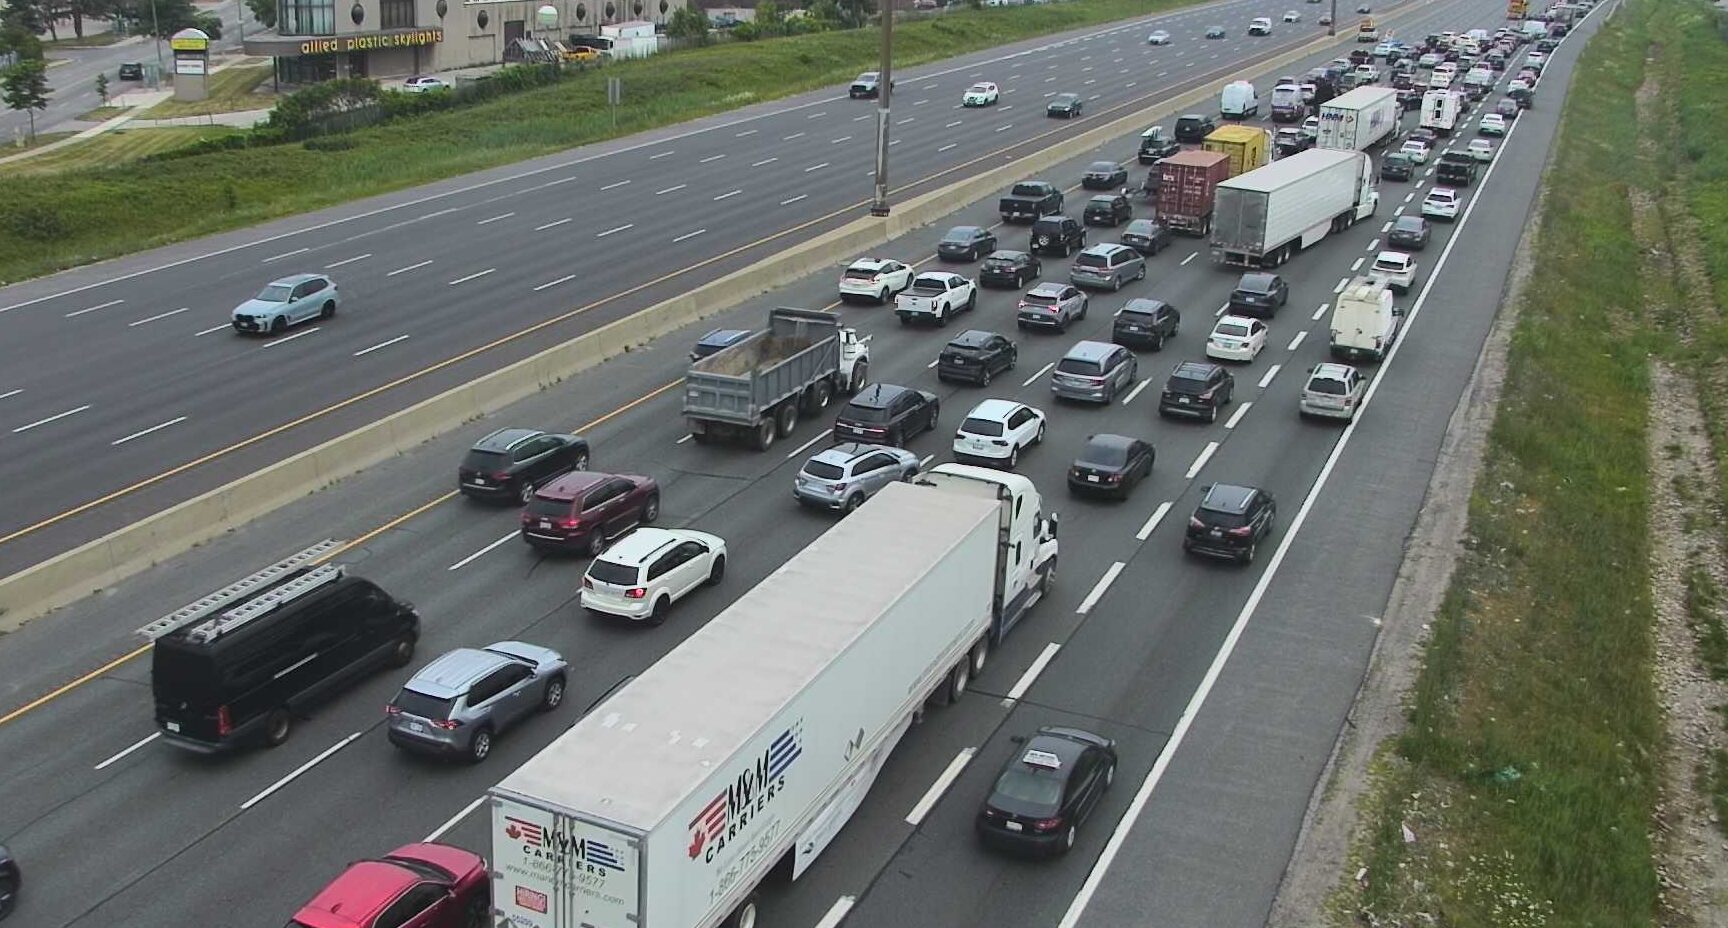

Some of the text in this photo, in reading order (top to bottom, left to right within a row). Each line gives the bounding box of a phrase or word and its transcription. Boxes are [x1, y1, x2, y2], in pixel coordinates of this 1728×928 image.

[301, 29, 442, 54] allied plastic skylights
[705, 776, 785, 863] CARRIERS
[523, 845, 606, 877] CARRERS
